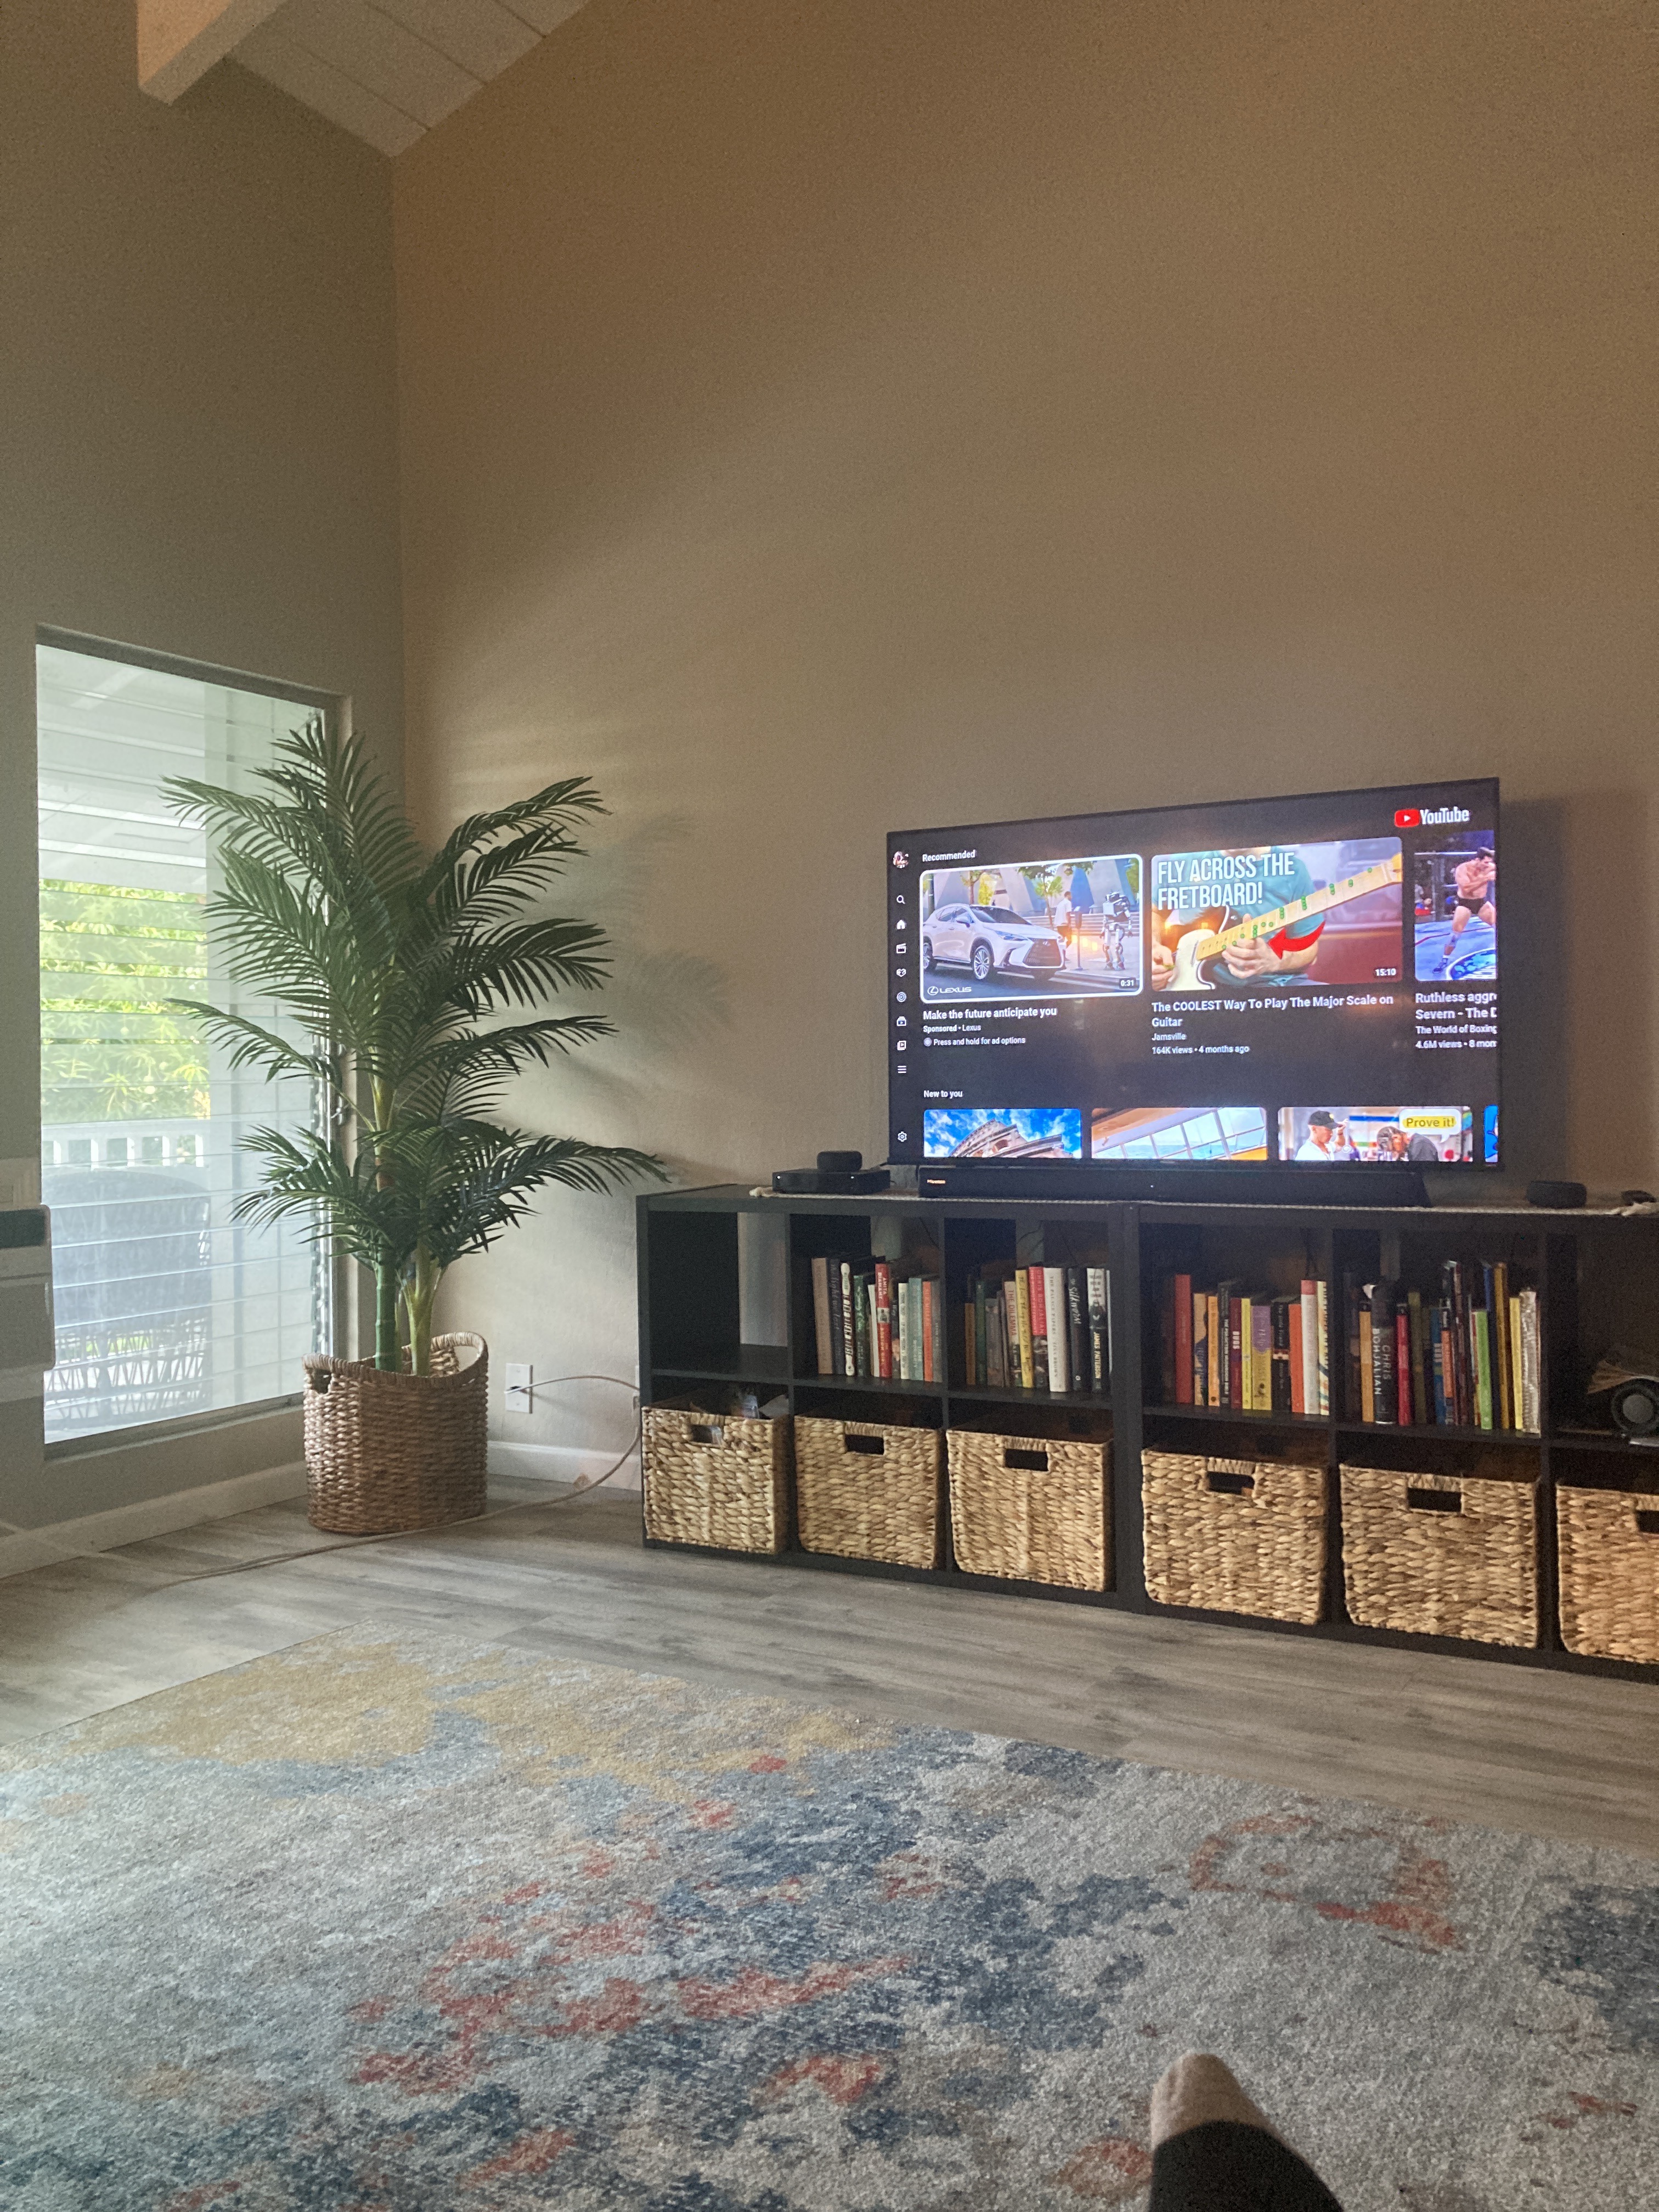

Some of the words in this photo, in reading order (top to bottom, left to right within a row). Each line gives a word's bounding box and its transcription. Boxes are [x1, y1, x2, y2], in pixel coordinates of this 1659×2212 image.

[1419, 806, 1470, 825] YouTube
[922, 849, 976, 862] Recommended
[1158, 860, 1186, 884] FLY
[1189, 855, 1257, 882] ACROSS
[1260, 852, 1295, 877] THE
[1158, 881, 1263, 910] FRETBOARD!
[1375, 968, 1397, 977] 15:10
[1152, 1002, 1171, 1012] The
[1173, 1000, 1222, 1012] COOLEST
[1223, 1000, 1246, 1012] Way
[1248, 998, 1262, 1009] To
[1264, 997, 1289, 1010] Play
[1289, 997, 1311, 1008] The
[1312, 995, 1345, 1009] Major
[1346, 994, 1377, 1006] Scale
[1379, 996, 1394, 1005] on
[1415, 991, 1466, 1003] Ruthless
[1467, 992, 1497, 1005] aggr
[923, 1009, 947, 1020] Make
[949, 1009, 963, 1019] the
[964, 1008, 992, 1018] future
[993, 1007, 1039, 1019] anticipate
[1040, 1008, 1058, 1018] you
[1415, 1009, 1456, 1019] Severn
[1465, 1007, 1489, 1018] The
[1152, 1017, 1183, 1027] Guitar
[923, 1024, 957, 1034] Sponsored
[1415, 1025, 1432, 1034] The
[1432, 1025, 1458, 1034] World
[1458, 1024, 1469, 1033] of
[1001, 1037, 1026, 1046] options
[1152, 1032, 1187, 1041] Jamsville
[1234, 1046, 1250, 1054] ago
[1415, 1040, 1437, 1048] 4.6M
[949, 1091, 963, 1099] you
[1406, 1118, 1440, 1127] Prove
[1443, 1118, 1455, 1127] it!
[1008, 1304, 1017, 1336] DILEMMA
[1372, 1328, 1383, 1395] BOHJALIAN
[1382, 1345, 1392, 1380] CHRIS
